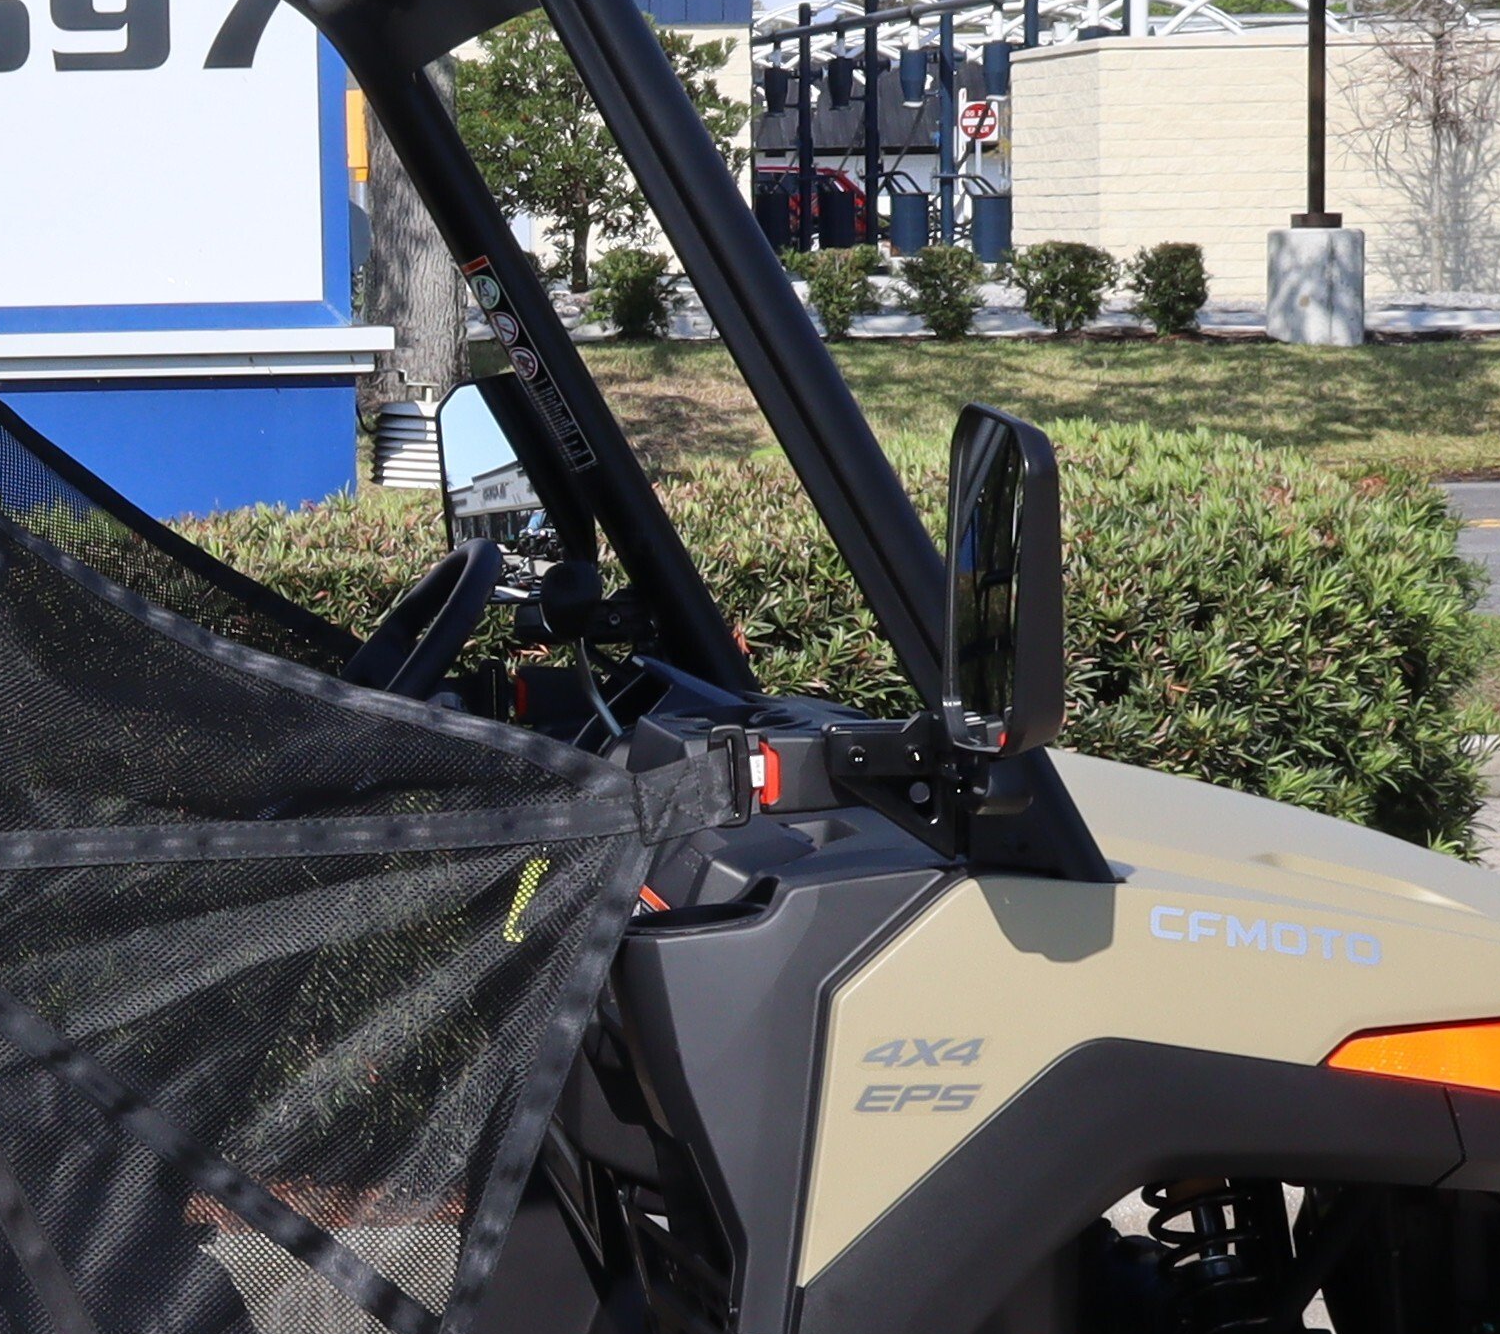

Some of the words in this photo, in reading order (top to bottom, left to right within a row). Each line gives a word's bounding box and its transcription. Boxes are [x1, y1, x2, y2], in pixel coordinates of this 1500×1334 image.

[1149, 905, 1384, 968] CFMOTO
[861, 1036, 985, 1067] 4X4
[853, 1083, 983, 1113] EPS
